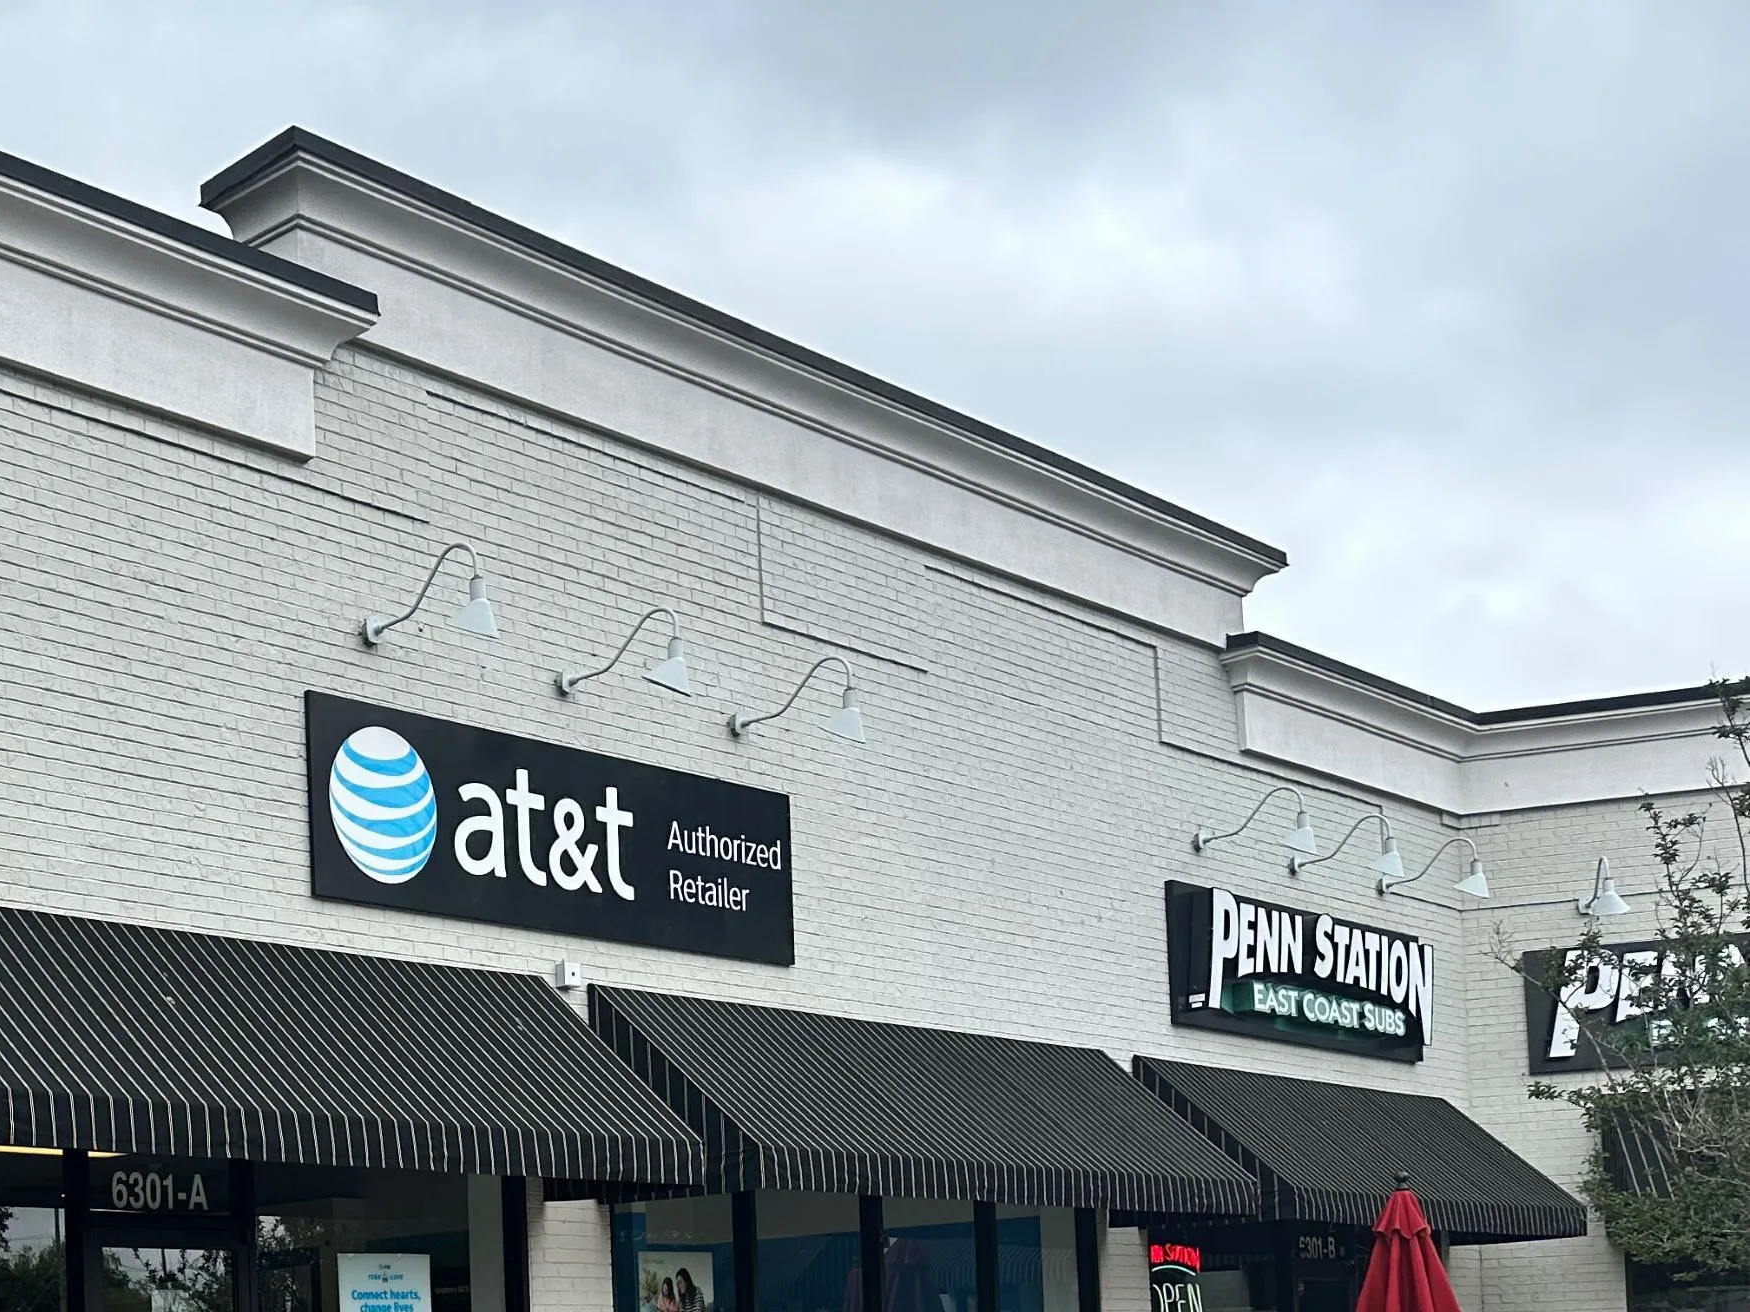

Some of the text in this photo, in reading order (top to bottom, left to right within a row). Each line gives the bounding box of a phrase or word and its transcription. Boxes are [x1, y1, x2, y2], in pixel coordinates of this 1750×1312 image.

[453, 768, 635, 900] at&t
[667, 820, 783, 871] Authorized
[668, 869, 750, 912] Retailer
[1208, 887, 1434, 1046] PENN STATION
[1252, 980, 1408, 1037] EAST COAST SUBS
[111, 1170, 210, 1211] 6301-A
[351, 1289, 388, 1301] Connect
[389, 1289, 421, 1302] hearts,
[393, 1301, 414, 1312] lives
